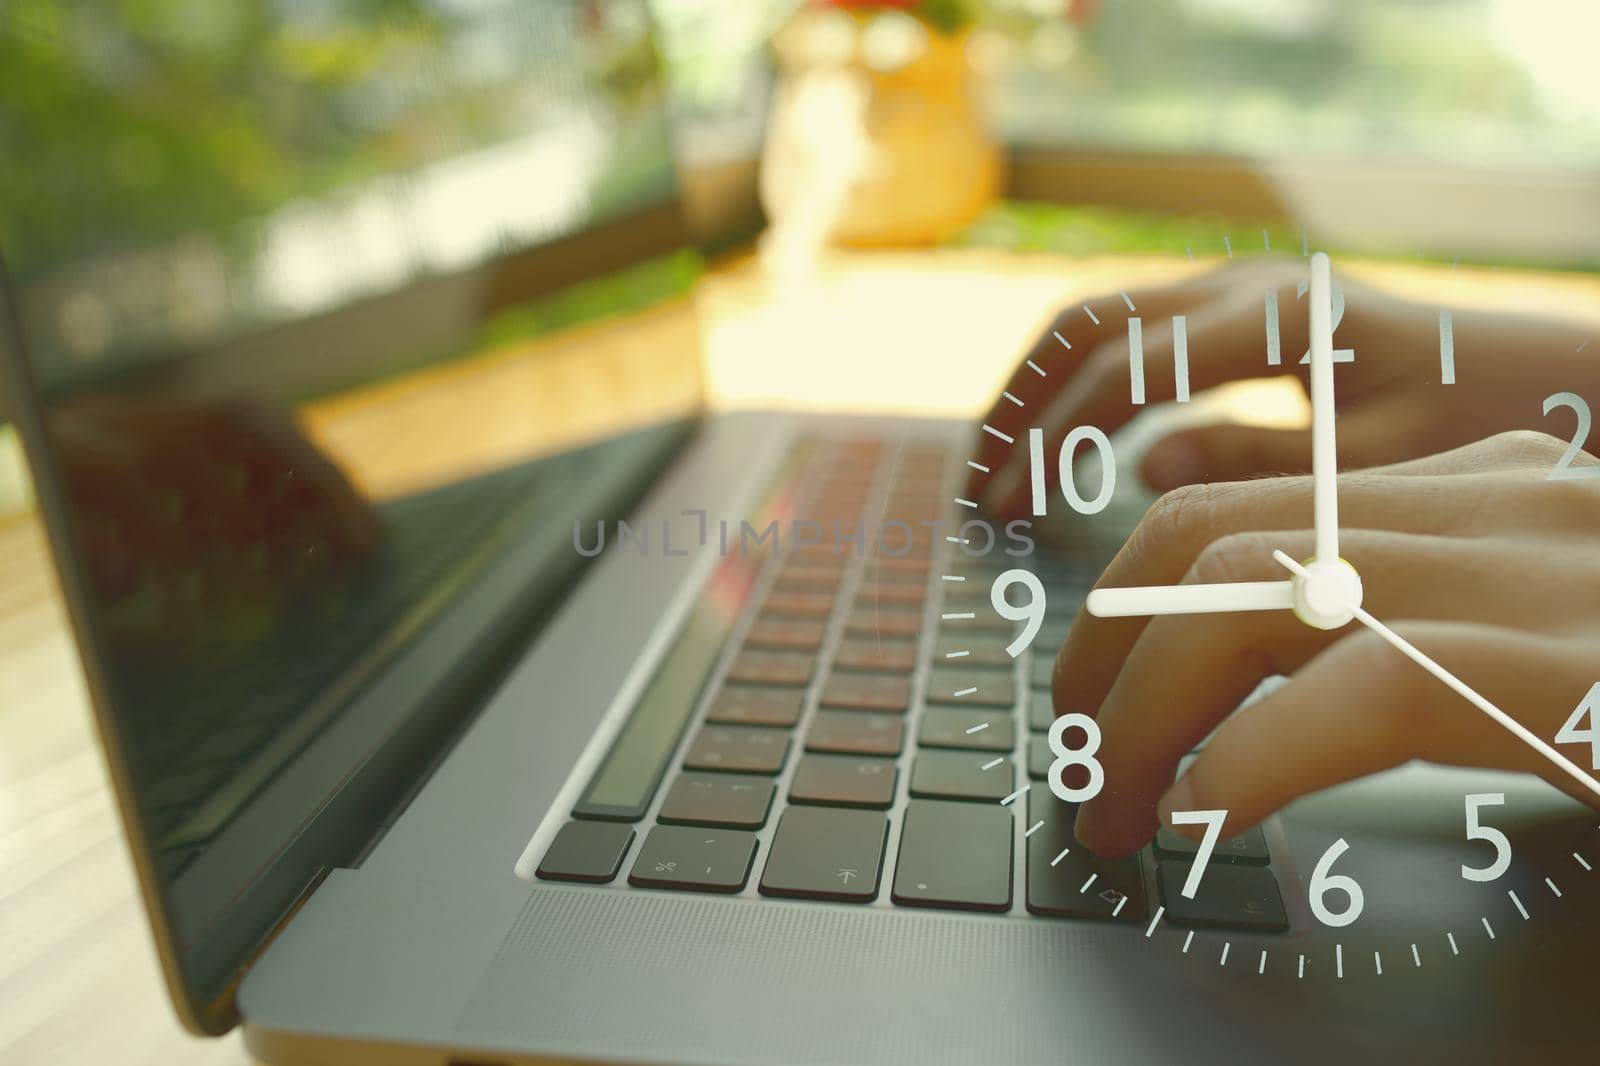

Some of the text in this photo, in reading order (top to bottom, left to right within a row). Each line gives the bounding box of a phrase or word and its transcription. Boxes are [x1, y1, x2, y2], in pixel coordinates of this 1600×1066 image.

[1128, 315, 1190, 404] 11
[1265, 279, 1354, 365] 12
[1439, 308, 1455, 384] 1
[1029, 425, 1117, 516] 10
[1543, 392, 1600, 480] 2
[990, 569, 1046, 658] 9
[1047, 713, 1104, 802] 8
[1554, 681, 1600, 770] 4
[1171, 809, 1228, 899] 7
[1309, 837, 1364, 927] 6
[1461, 793, 1511, 882] 5
